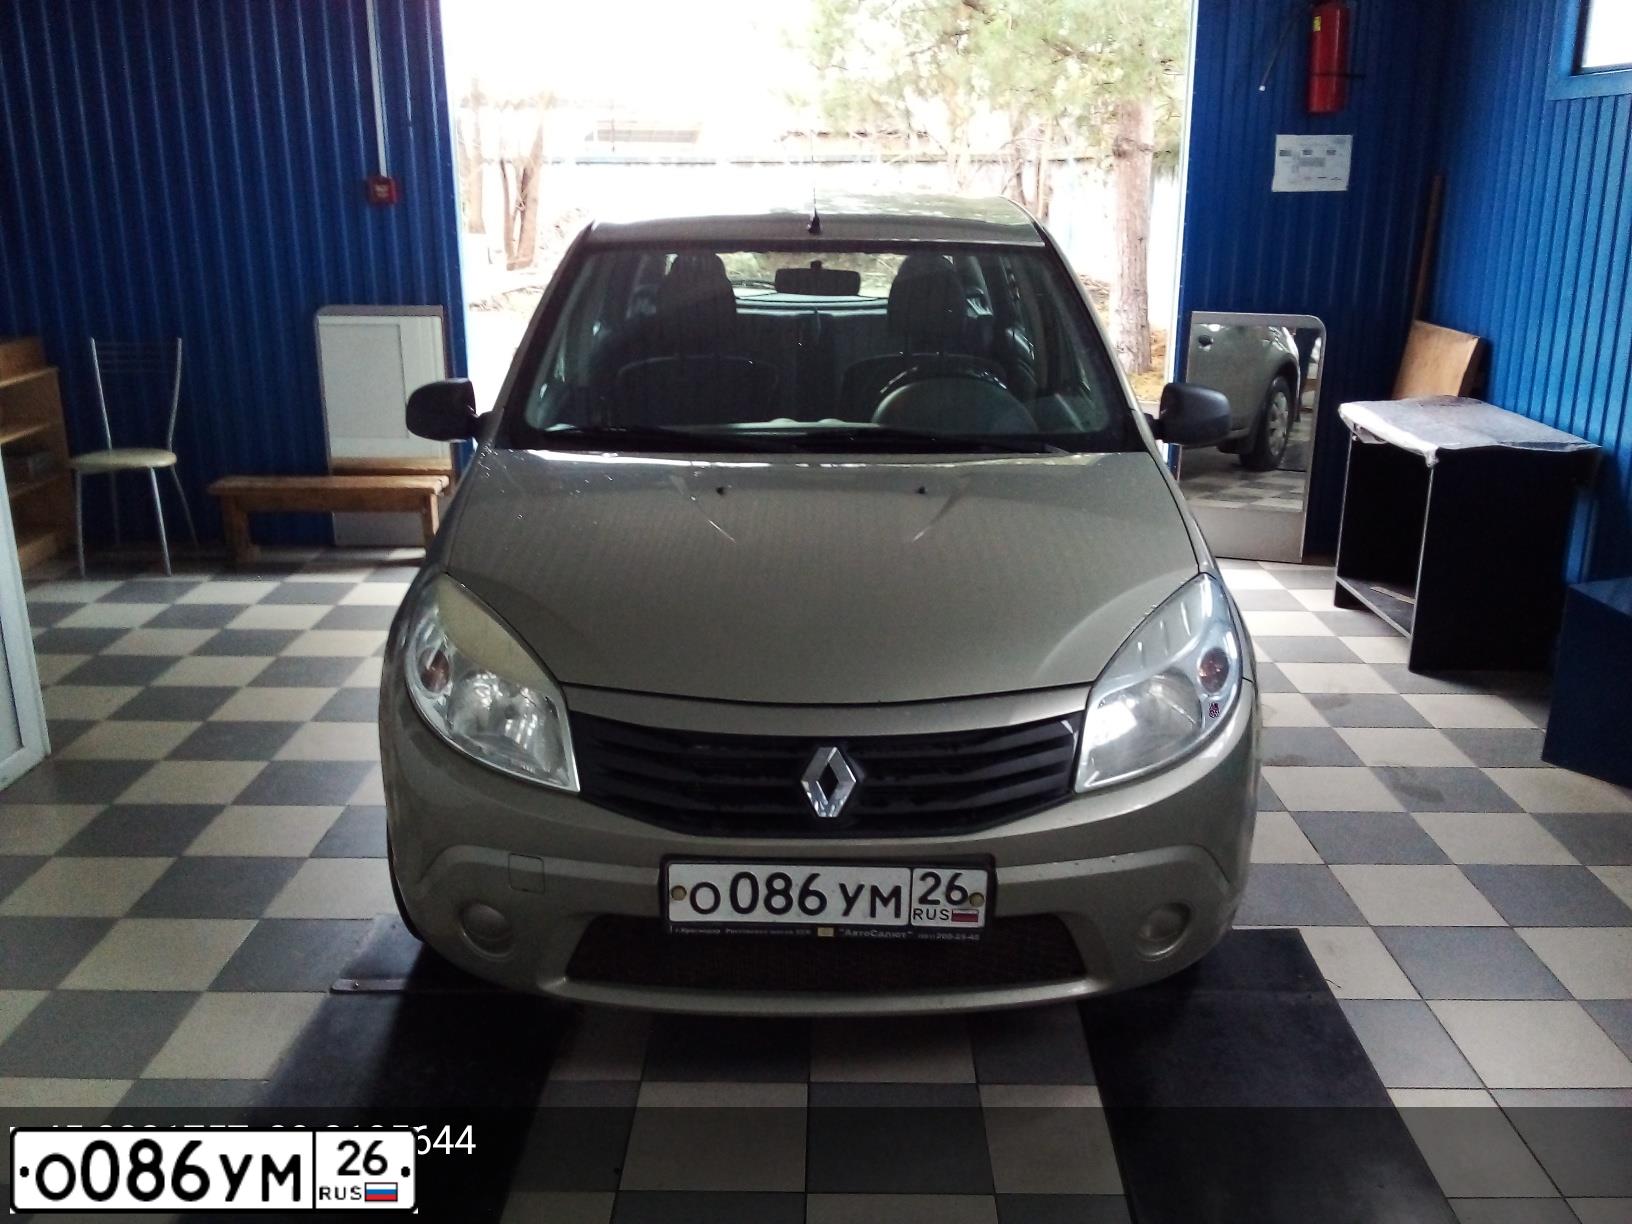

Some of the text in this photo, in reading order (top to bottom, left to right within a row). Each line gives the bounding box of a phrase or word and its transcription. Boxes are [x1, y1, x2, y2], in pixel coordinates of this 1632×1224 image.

[690, 872, 902, 918] О086УМ
[918, 871, 968, 906] 26
[913, 908, 950, 921] RUS
